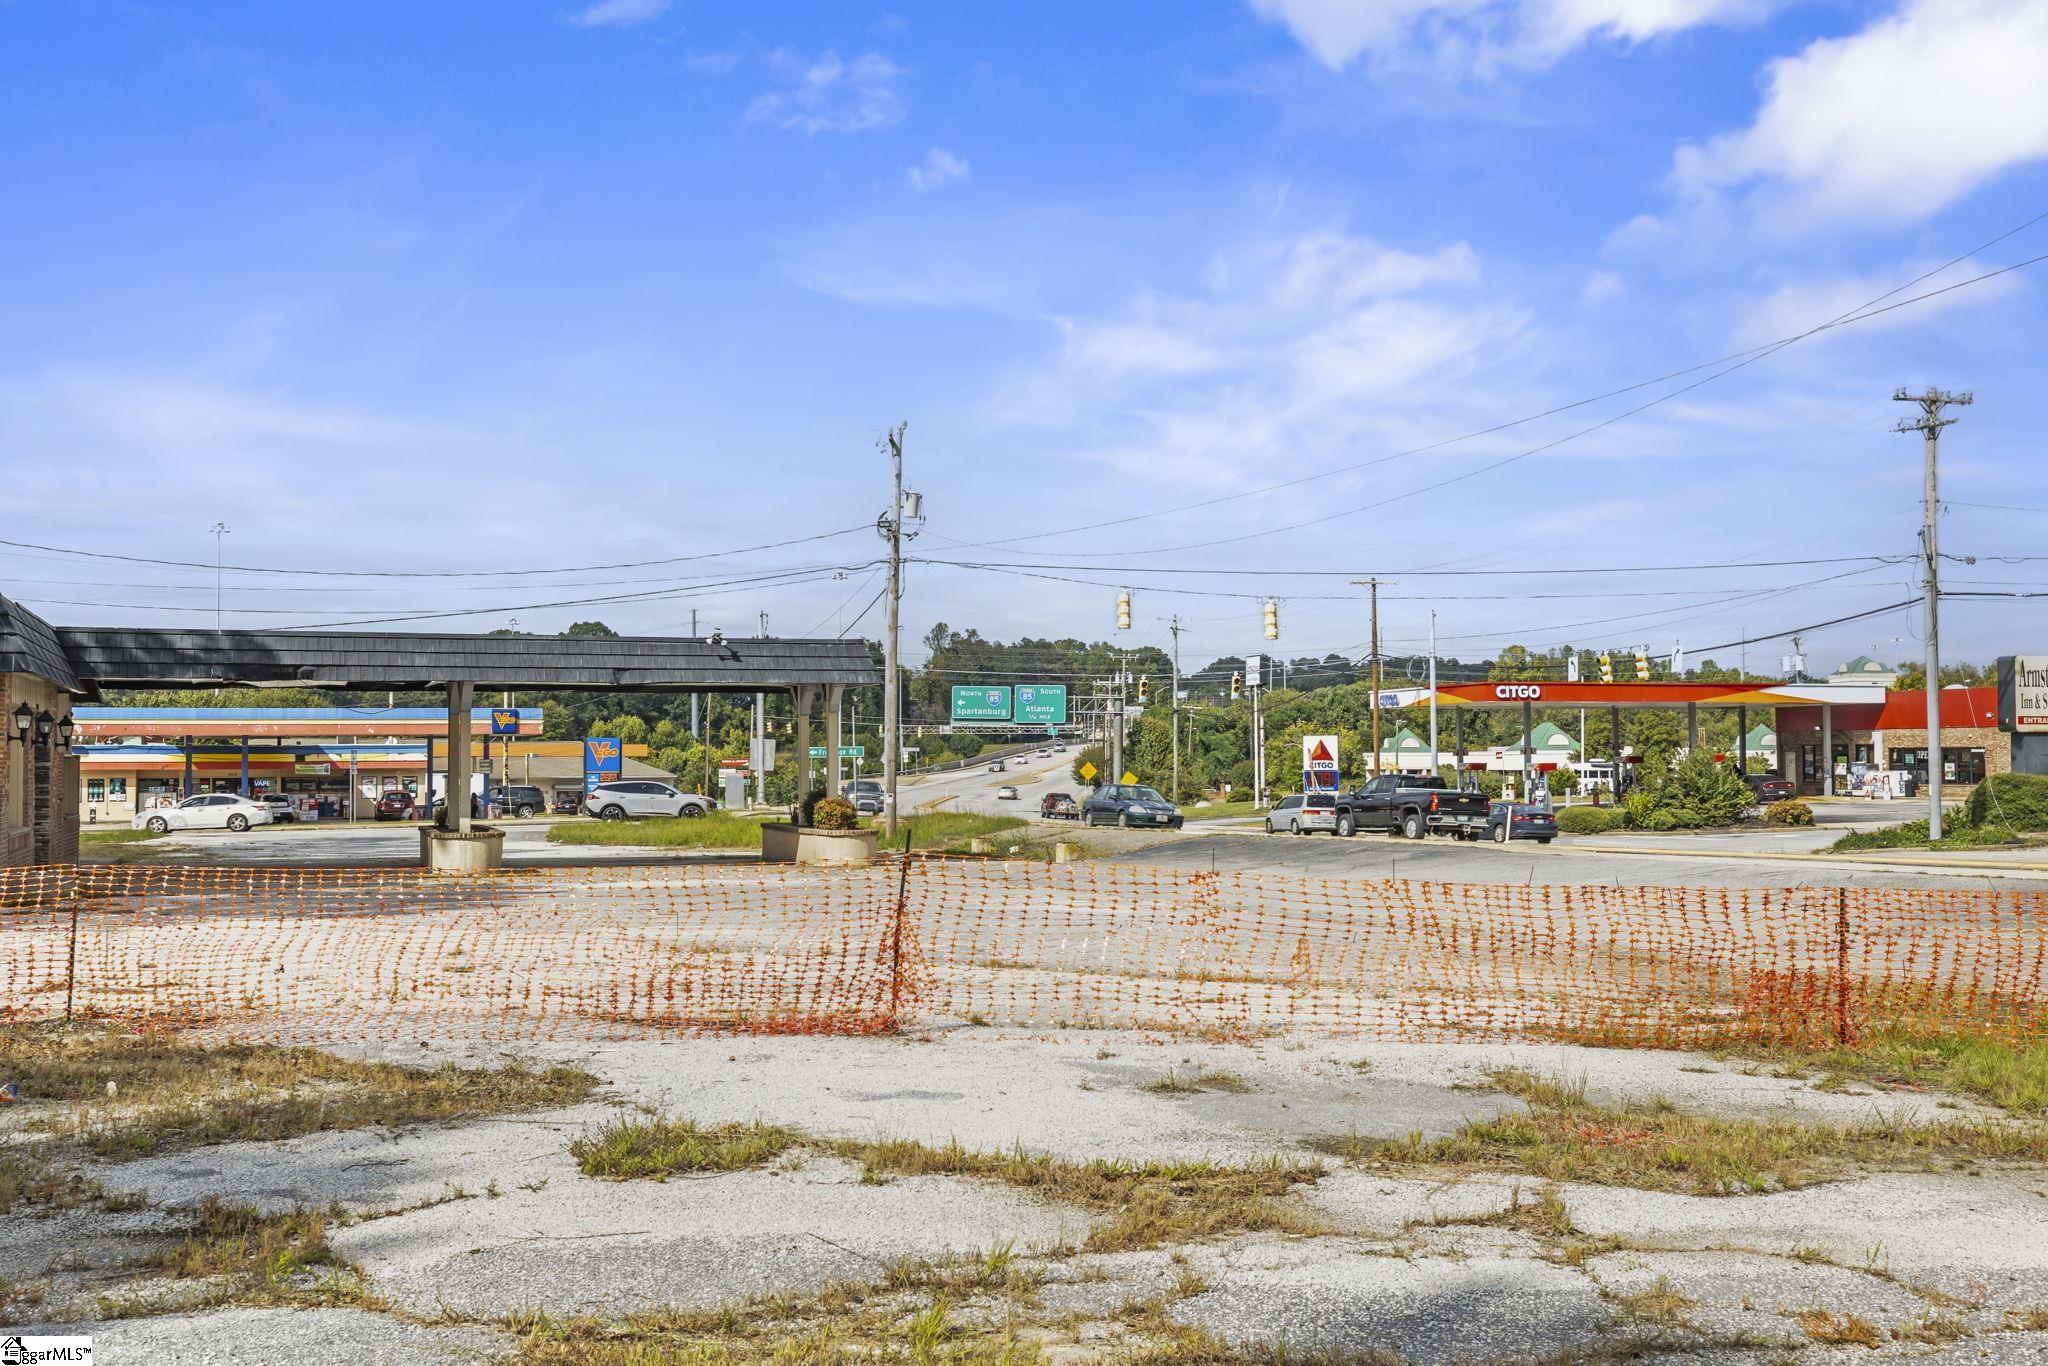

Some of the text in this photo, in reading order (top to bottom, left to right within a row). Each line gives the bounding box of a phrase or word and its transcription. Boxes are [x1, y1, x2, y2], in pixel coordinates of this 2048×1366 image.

[1496, 685, 1541, 699] CITGO
[2021, 693, 2033, 708] Inn
[2035, 693, 2041, 709] &
[956, 708, 1006, 716] Spartanburg
